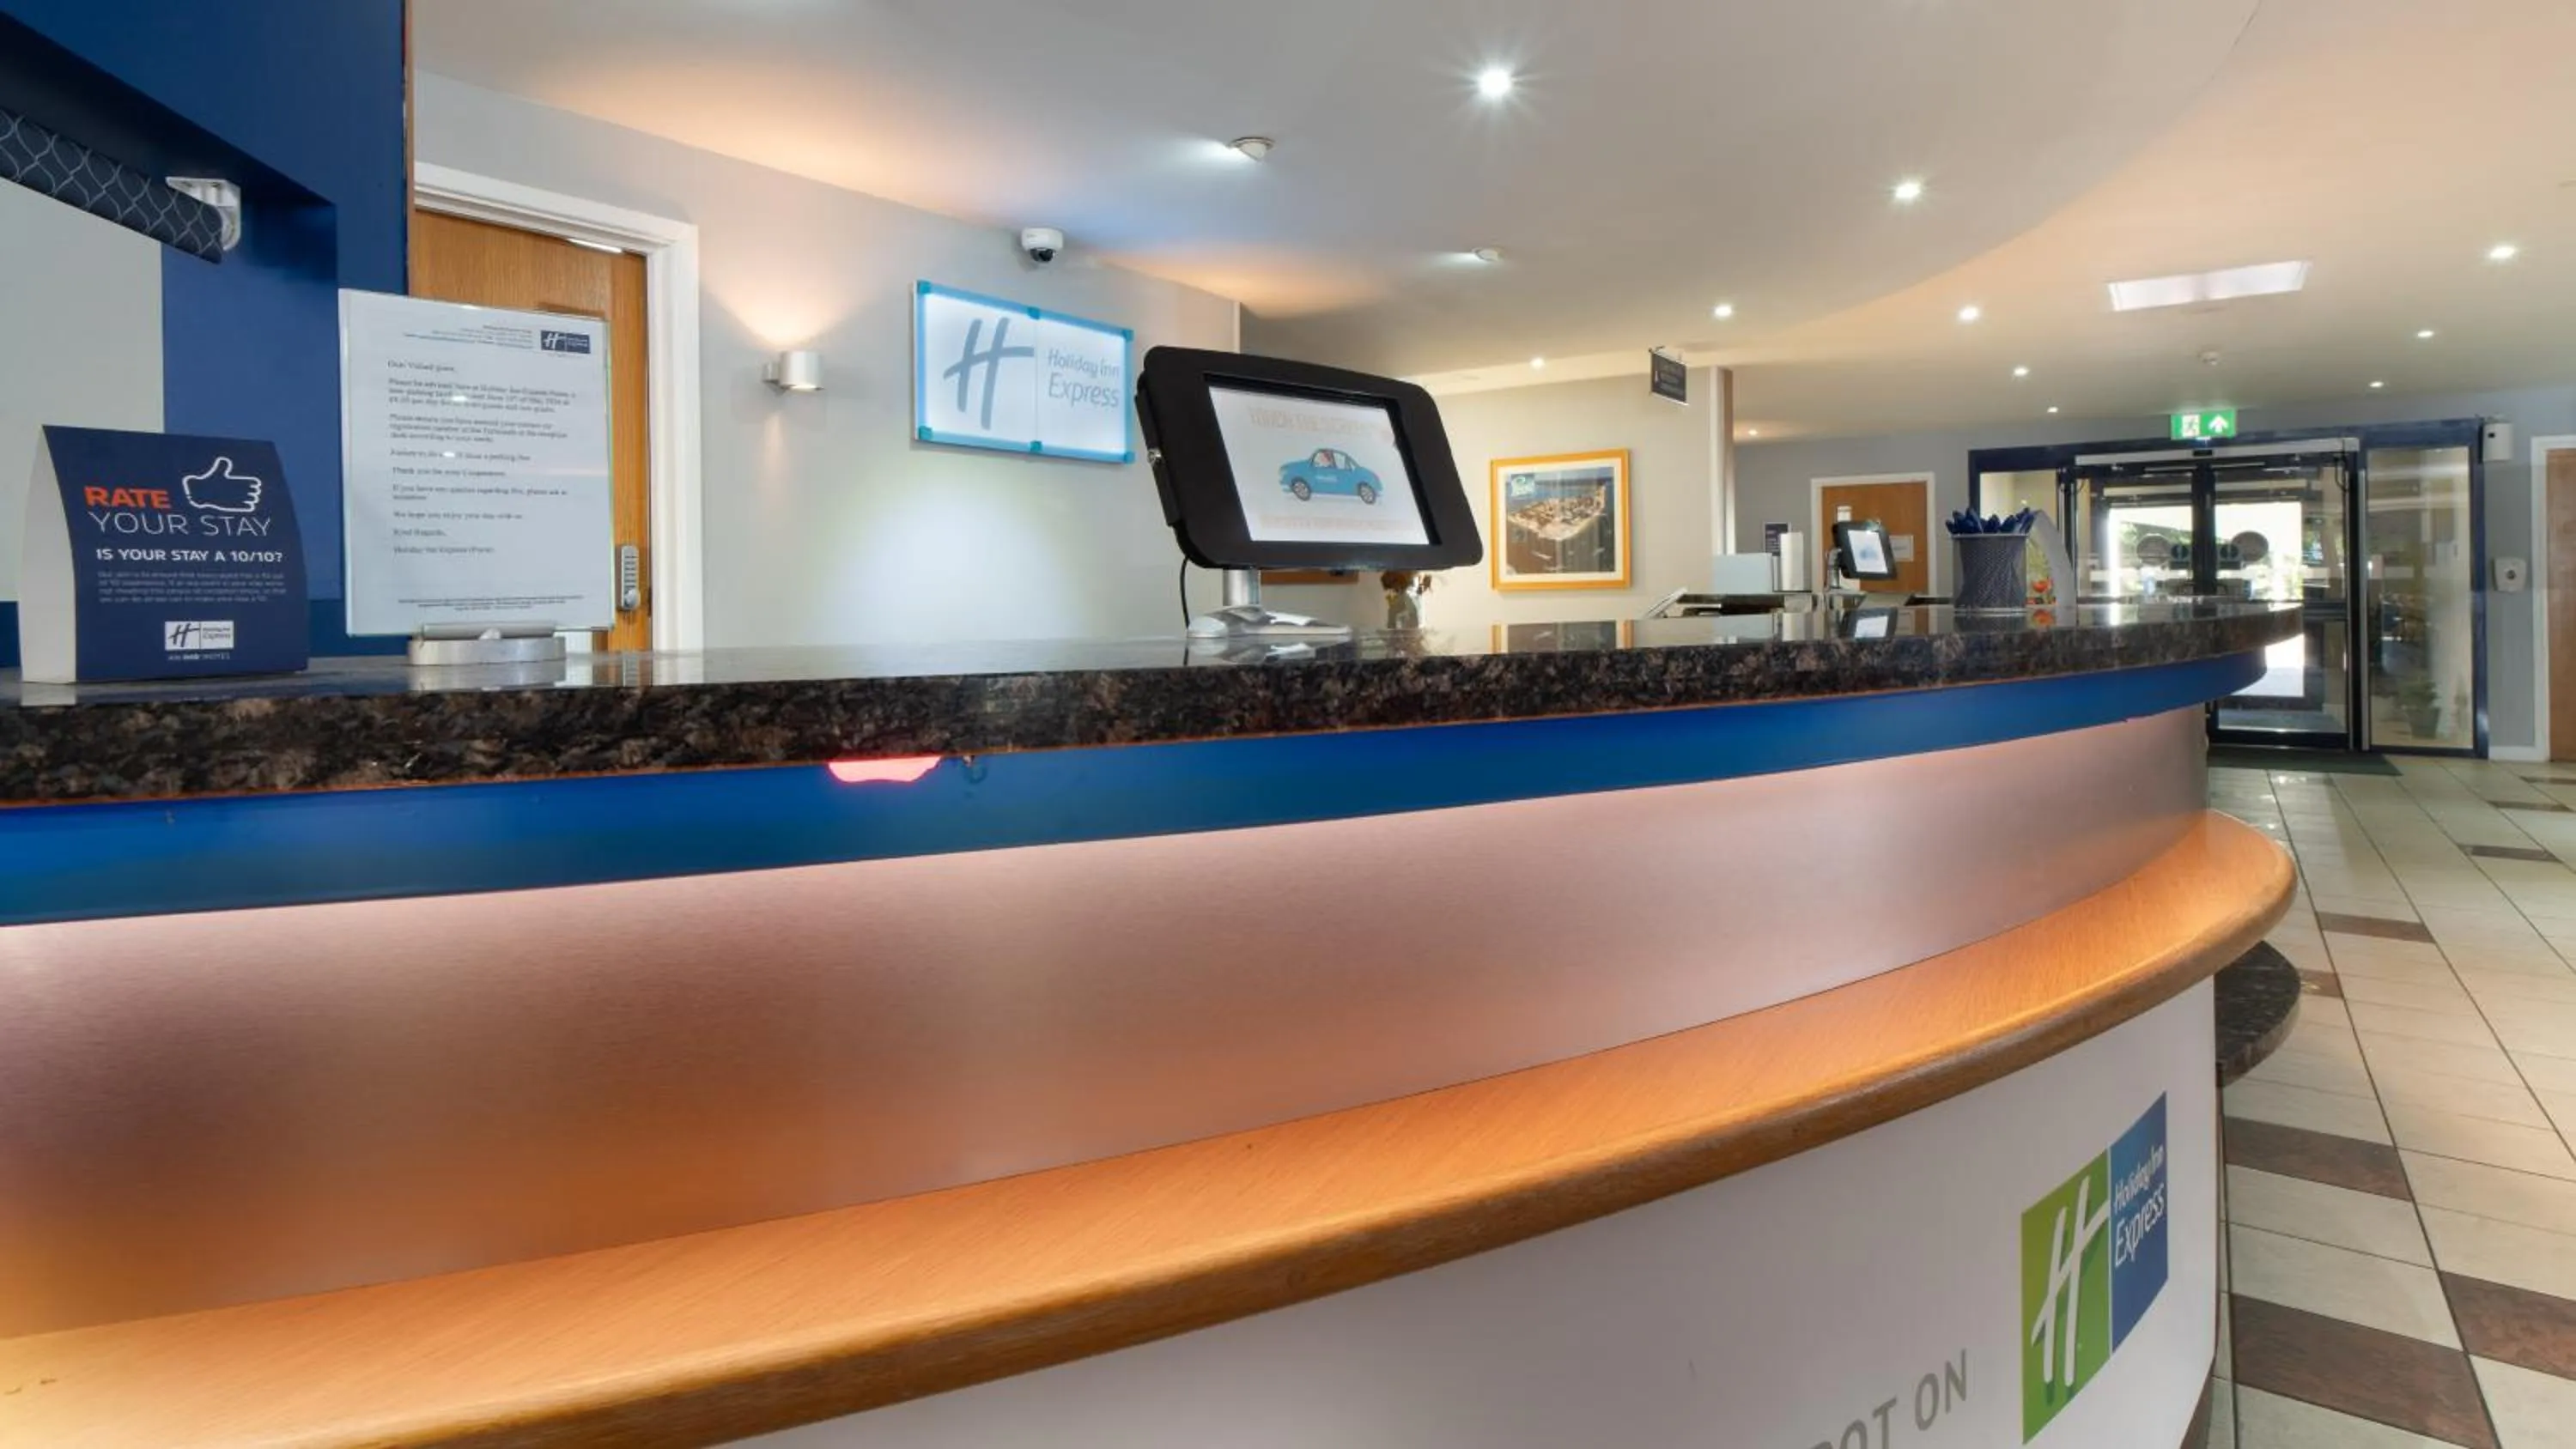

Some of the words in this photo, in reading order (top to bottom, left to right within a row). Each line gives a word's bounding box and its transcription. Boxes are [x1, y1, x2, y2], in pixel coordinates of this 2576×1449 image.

[1048, 349, 1097, 379] Holiday
[1100, 356, 1120, 378] Inn
[1048, 373, 1120, 408] Express
[84, 486, 170, 509] RATE
[88, 511, 188, 535] YOUR
[200, 515, 270, 537] STAY
[96, 548, 113, 560] IS
[118, 548, 167, 561] YOUR
[171, 549, 209, 561] STAY
[215, 550, 225, 561] A
[231, 550, 283, 562] 10/10?
[2114, 1159, 2150, 1214] Holiday
[2150, 1145, 2164, 1178] Inn
[2115, 1185, 2165, 1269] Express
[1810, 1396, 1897, 1449] OT
[1915, 1348, 1966, 1431] ON
